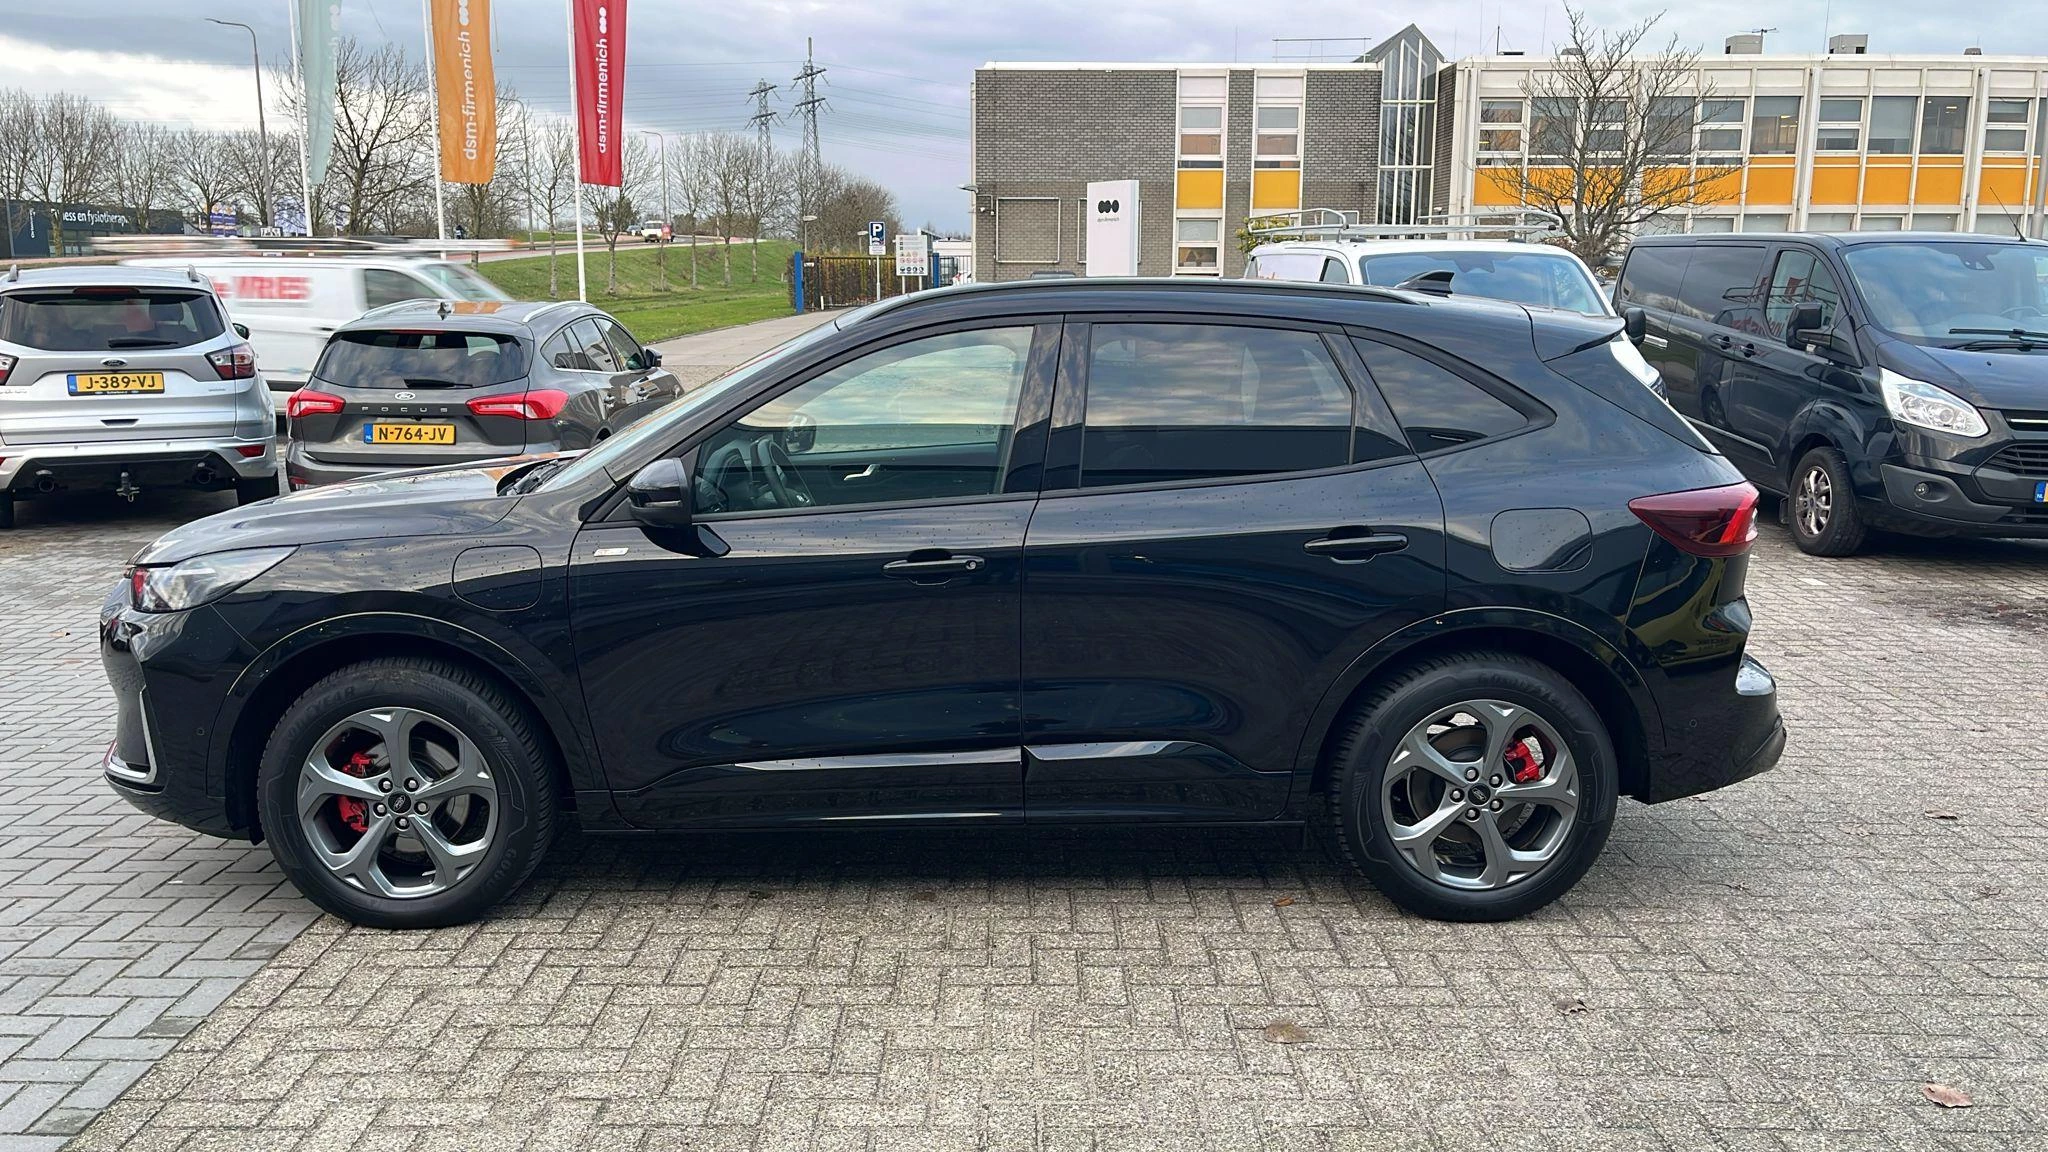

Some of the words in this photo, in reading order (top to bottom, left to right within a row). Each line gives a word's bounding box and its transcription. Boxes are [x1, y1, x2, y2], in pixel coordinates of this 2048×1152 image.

[459, 32, 477, 160] dsm-firmenich
[596, 38, 609, 154] dsm-firmenich
[77, 212, 87, 221] en
[872, 223, 883, 236] P
[86, 375, 156, 389] J-389-VJ
[379, 427, 447, 440] N-764-JV
